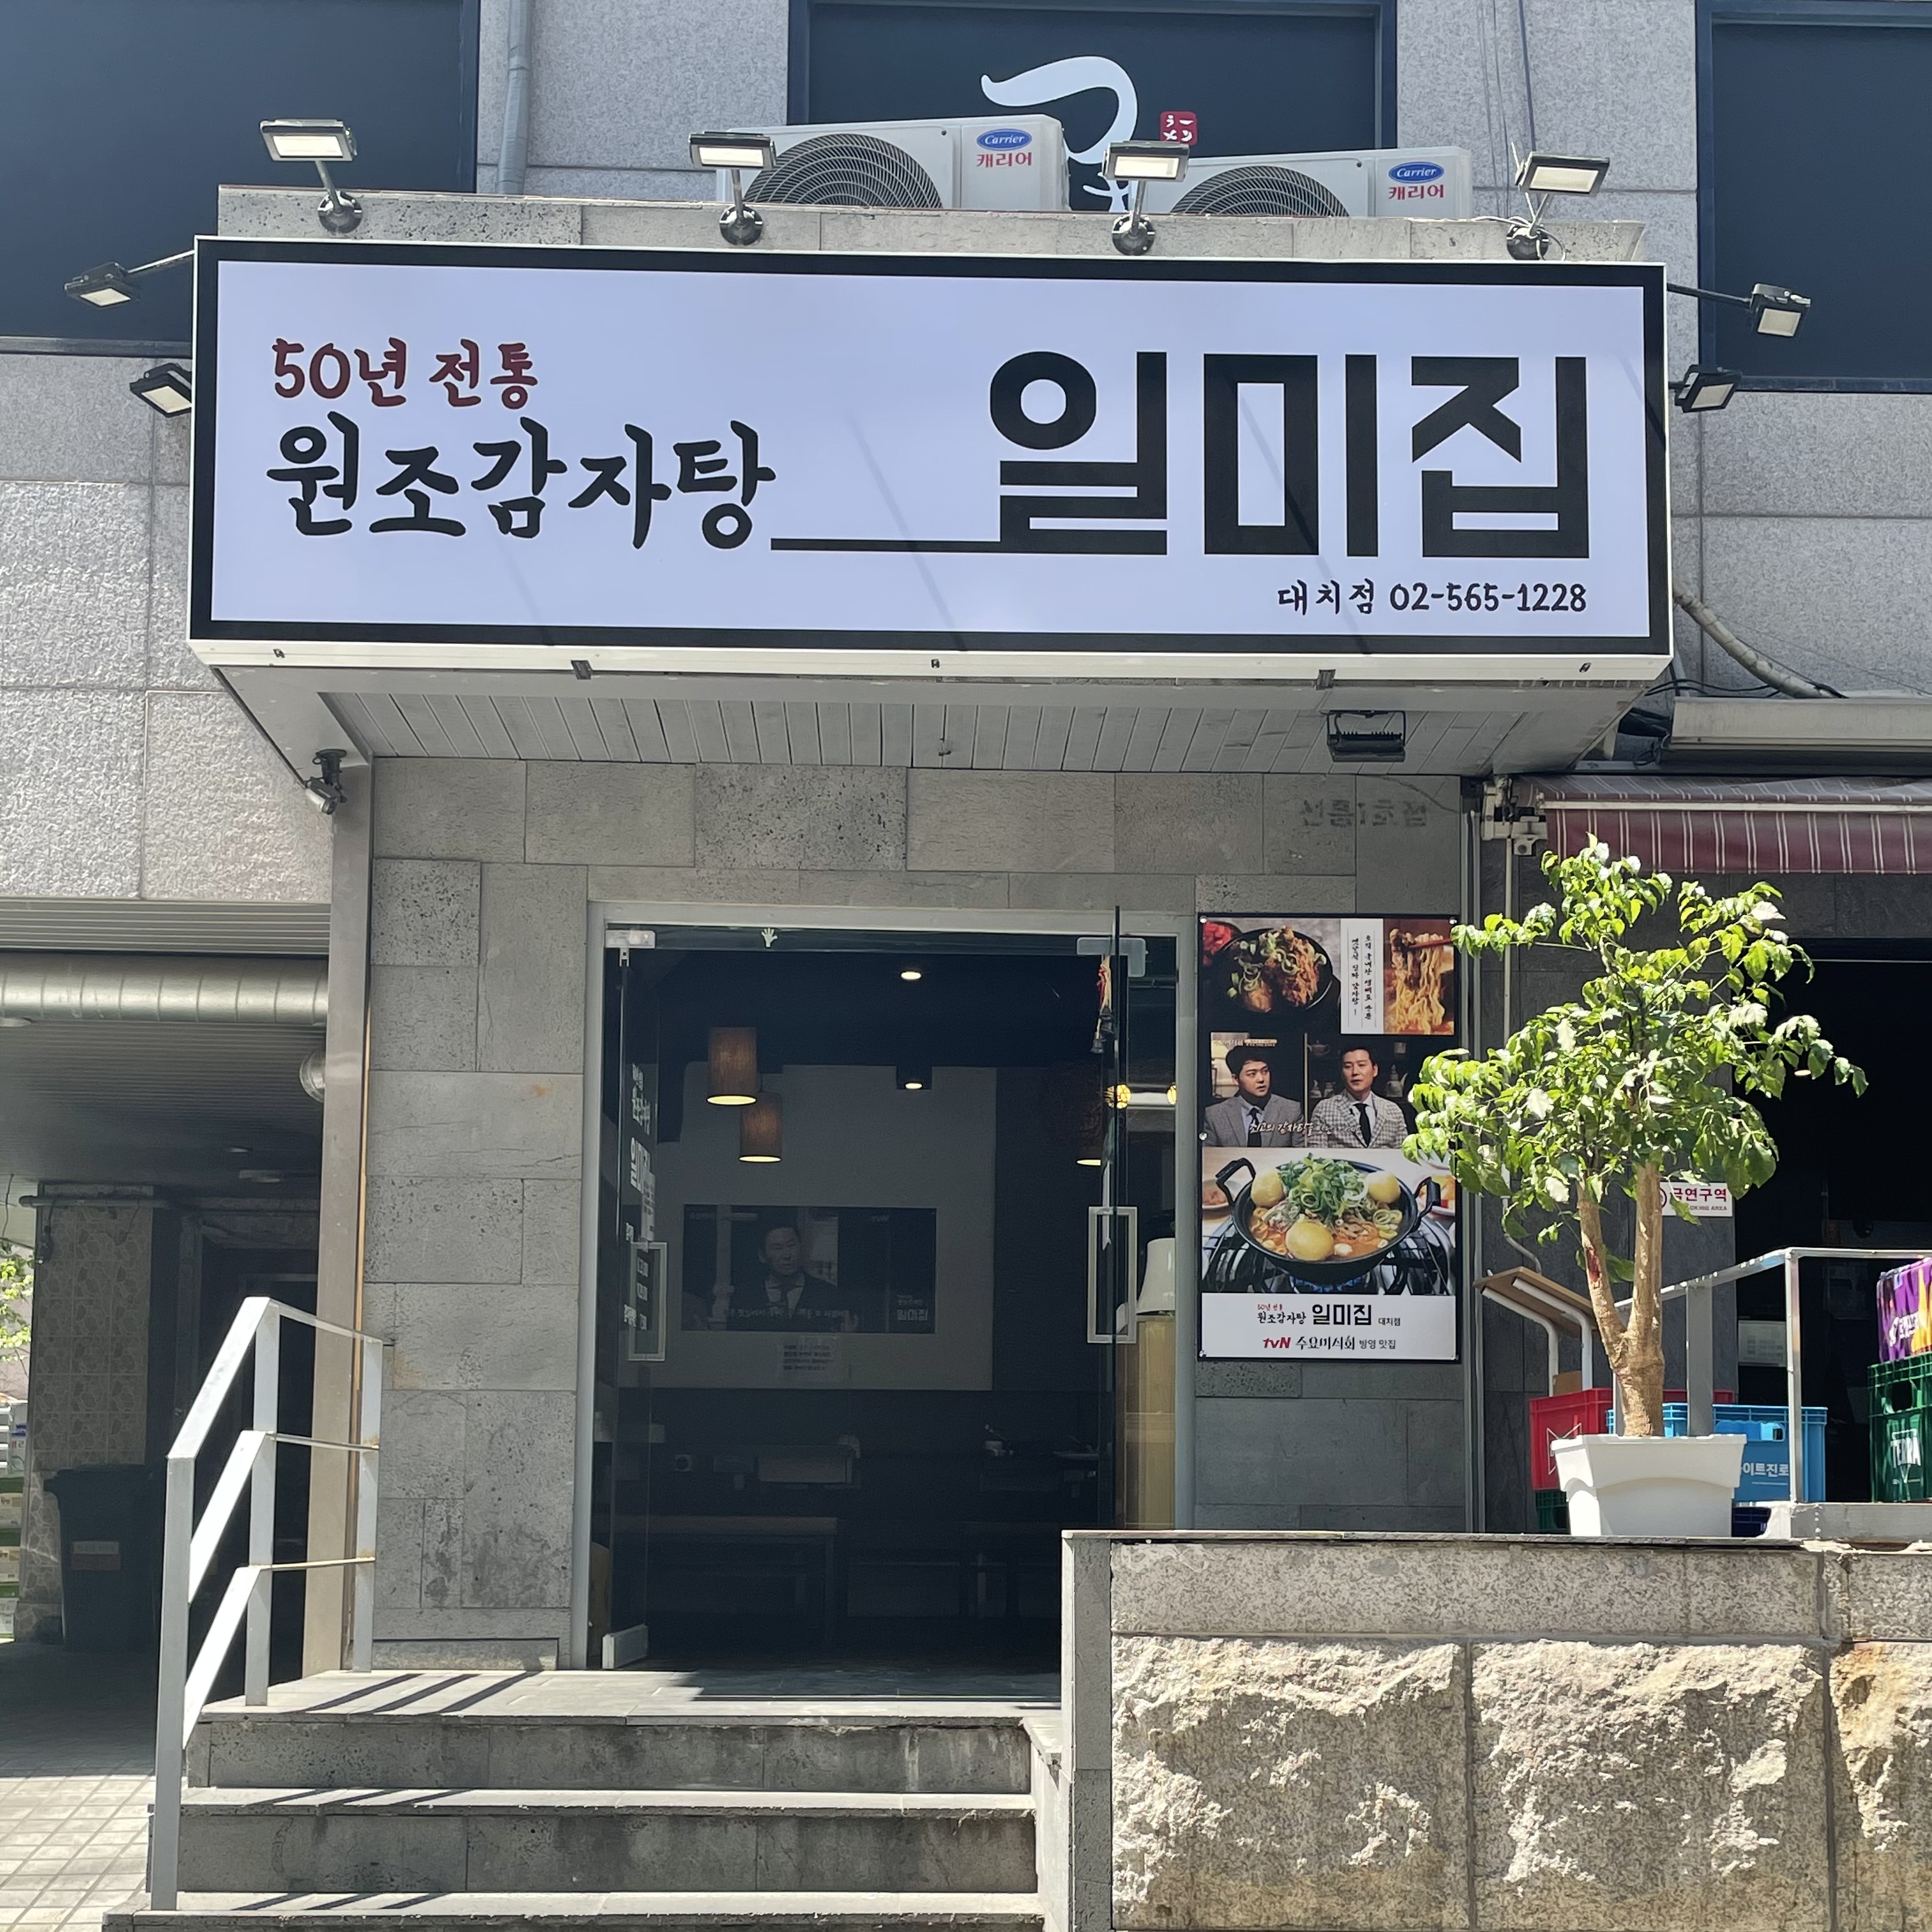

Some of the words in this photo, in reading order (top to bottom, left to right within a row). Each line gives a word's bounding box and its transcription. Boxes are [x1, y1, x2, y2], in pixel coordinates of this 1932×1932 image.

[985, 134, 1025, 145] Carrier
[976, 152, 1032, 168] 캐리어
[1396, 166, 1438, 178] Carrier
[1388, 183, 1445, 201] 캐리어
[272, 337, 408, 408] 50년
[429, 339, 539, 410] 전통
[990, 351, 1589, 558] 일미집
[266, 411, 777, 552] 원조감자탕
[1278, 578, 1374, 616] 대치점
[1390, 582, 1587, 611] 02-565-1228
[1257, 1311, 1307, 1324] 원조감자탕
[1312, 1303, 1372, 1326] 일미집
[1378, 1317, 1401, 1326] 대치점
[1262, 1337, 1291, 1349] tvN
[1295, 1335, 1355, 1351] 수요미식회
[1359, 1339, 1376, 1349] 방영
[1378, 1339, 1397, 1349] 맛집
[1740, 1462, 1790, 1478] 이트진로
